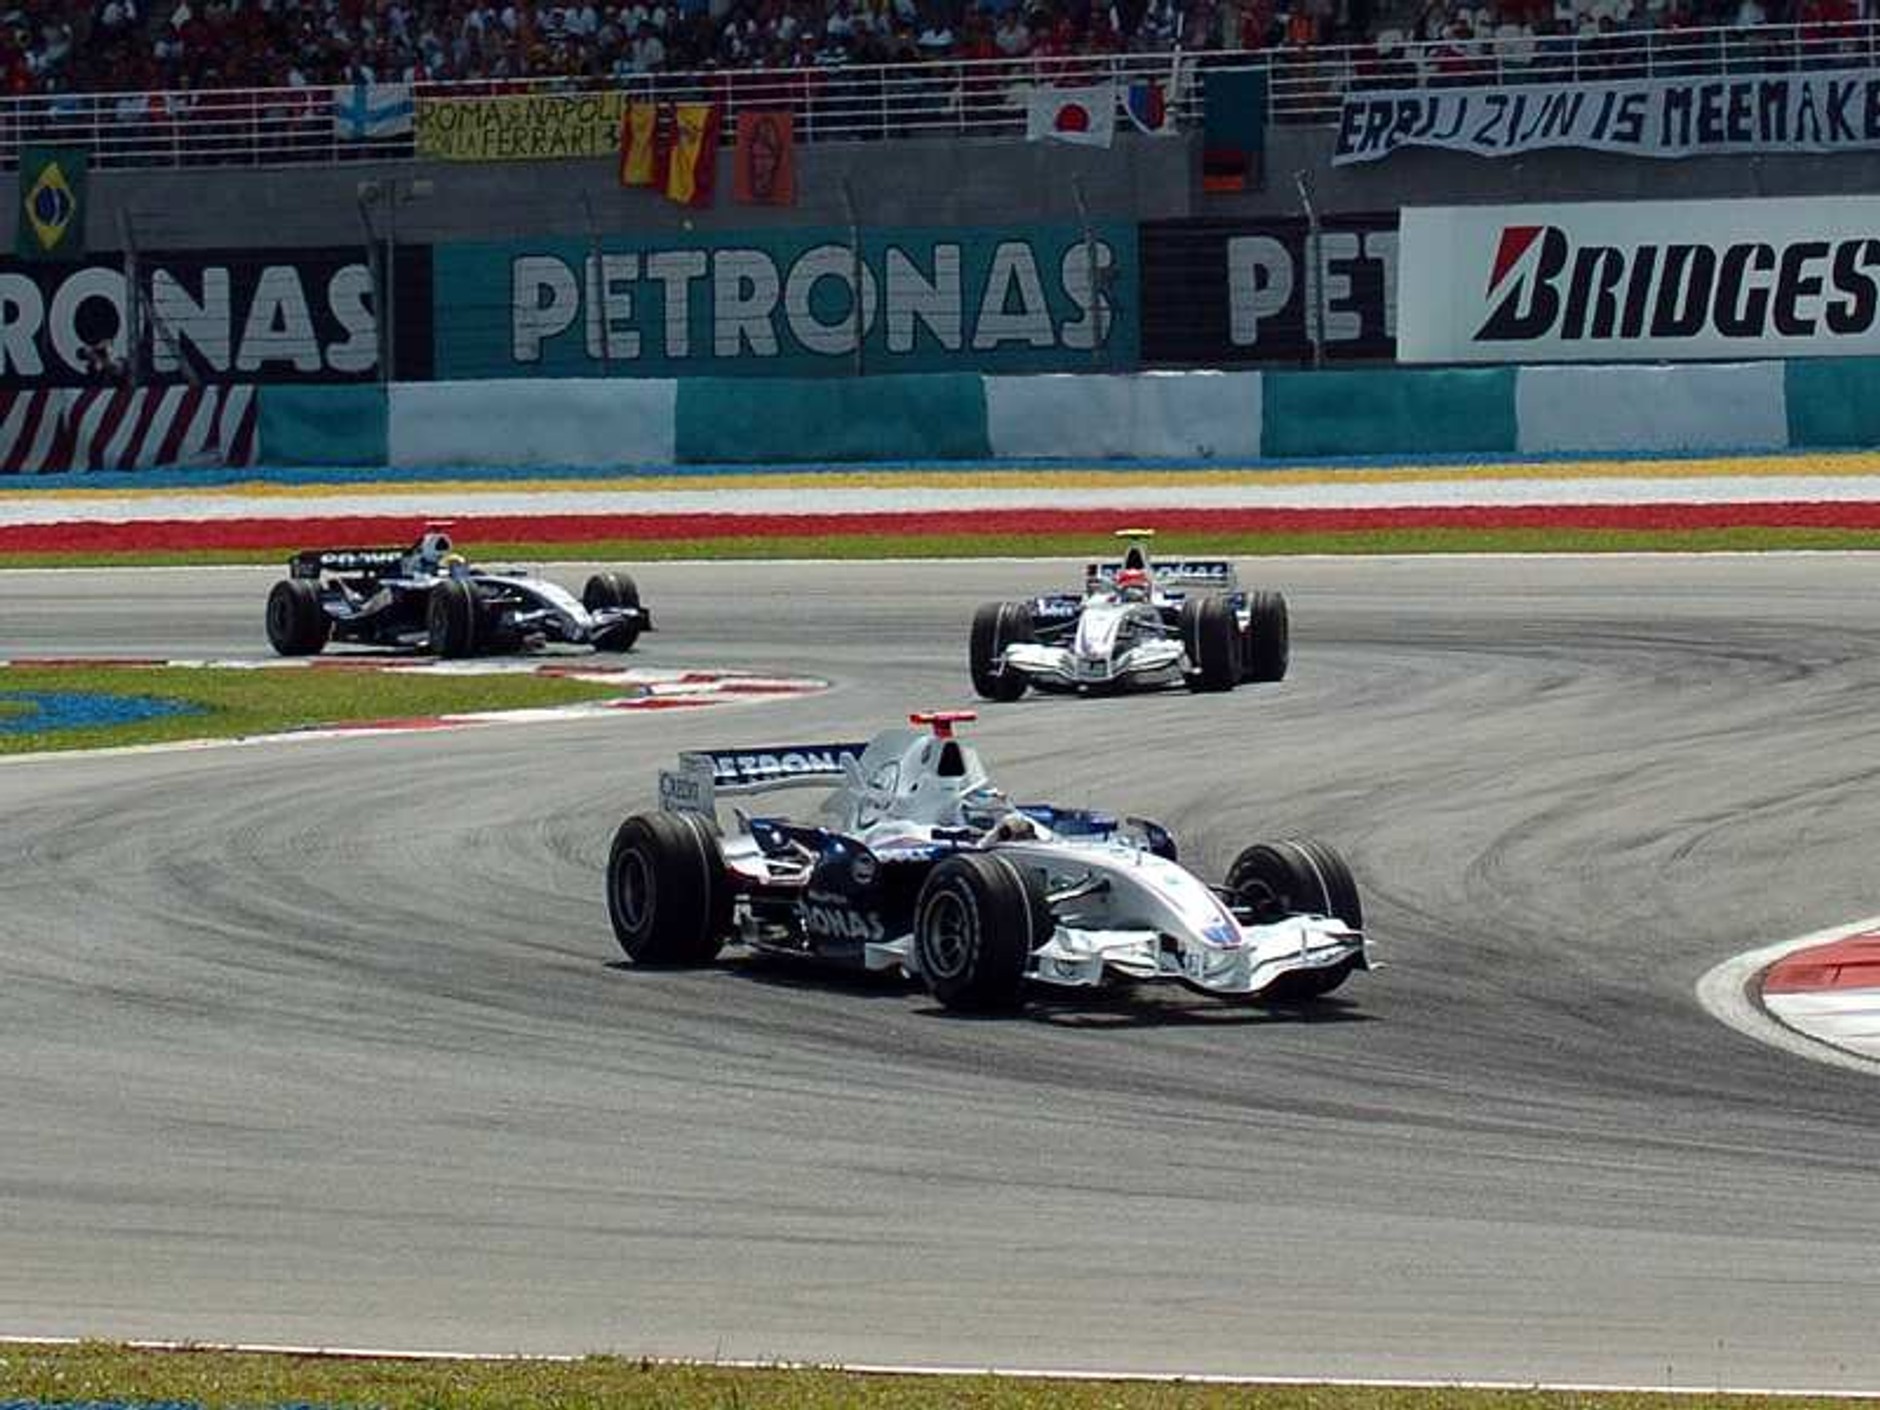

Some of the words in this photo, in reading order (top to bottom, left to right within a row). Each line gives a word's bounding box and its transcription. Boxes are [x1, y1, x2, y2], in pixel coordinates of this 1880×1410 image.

[416, 101, 501, 134] ROMA
[526, 96, 623, 126] NAPOLI
[482, 126, 597, 156] FERRARI
[1592, 91, 1648, 143] IS
[512, 242, 1112, 362] PETRONAS
[1472, 224, 1880, 342] BRIDGES
